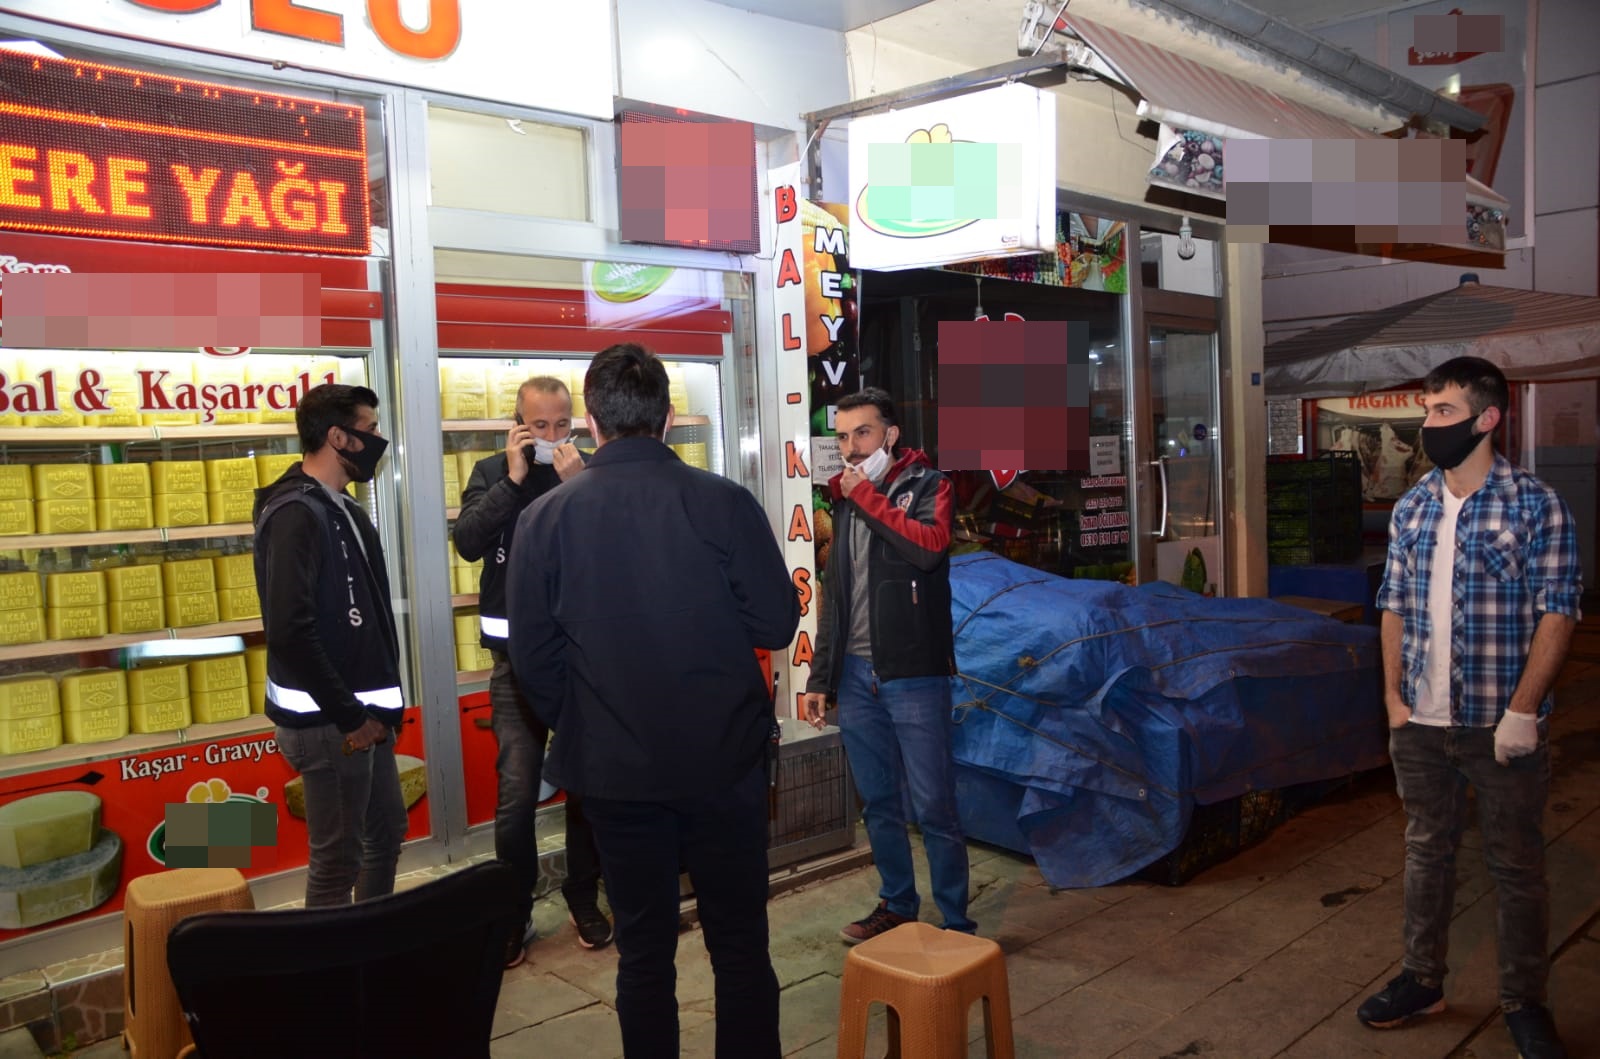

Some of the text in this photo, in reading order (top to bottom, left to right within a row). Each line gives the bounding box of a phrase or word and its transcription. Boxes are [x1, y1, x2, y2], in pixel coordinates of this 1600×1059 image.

[169, 159, 349, 235] YAĞI
[72, 368, 113, 412] &
[120, 753, 187, 781] Kaşar
